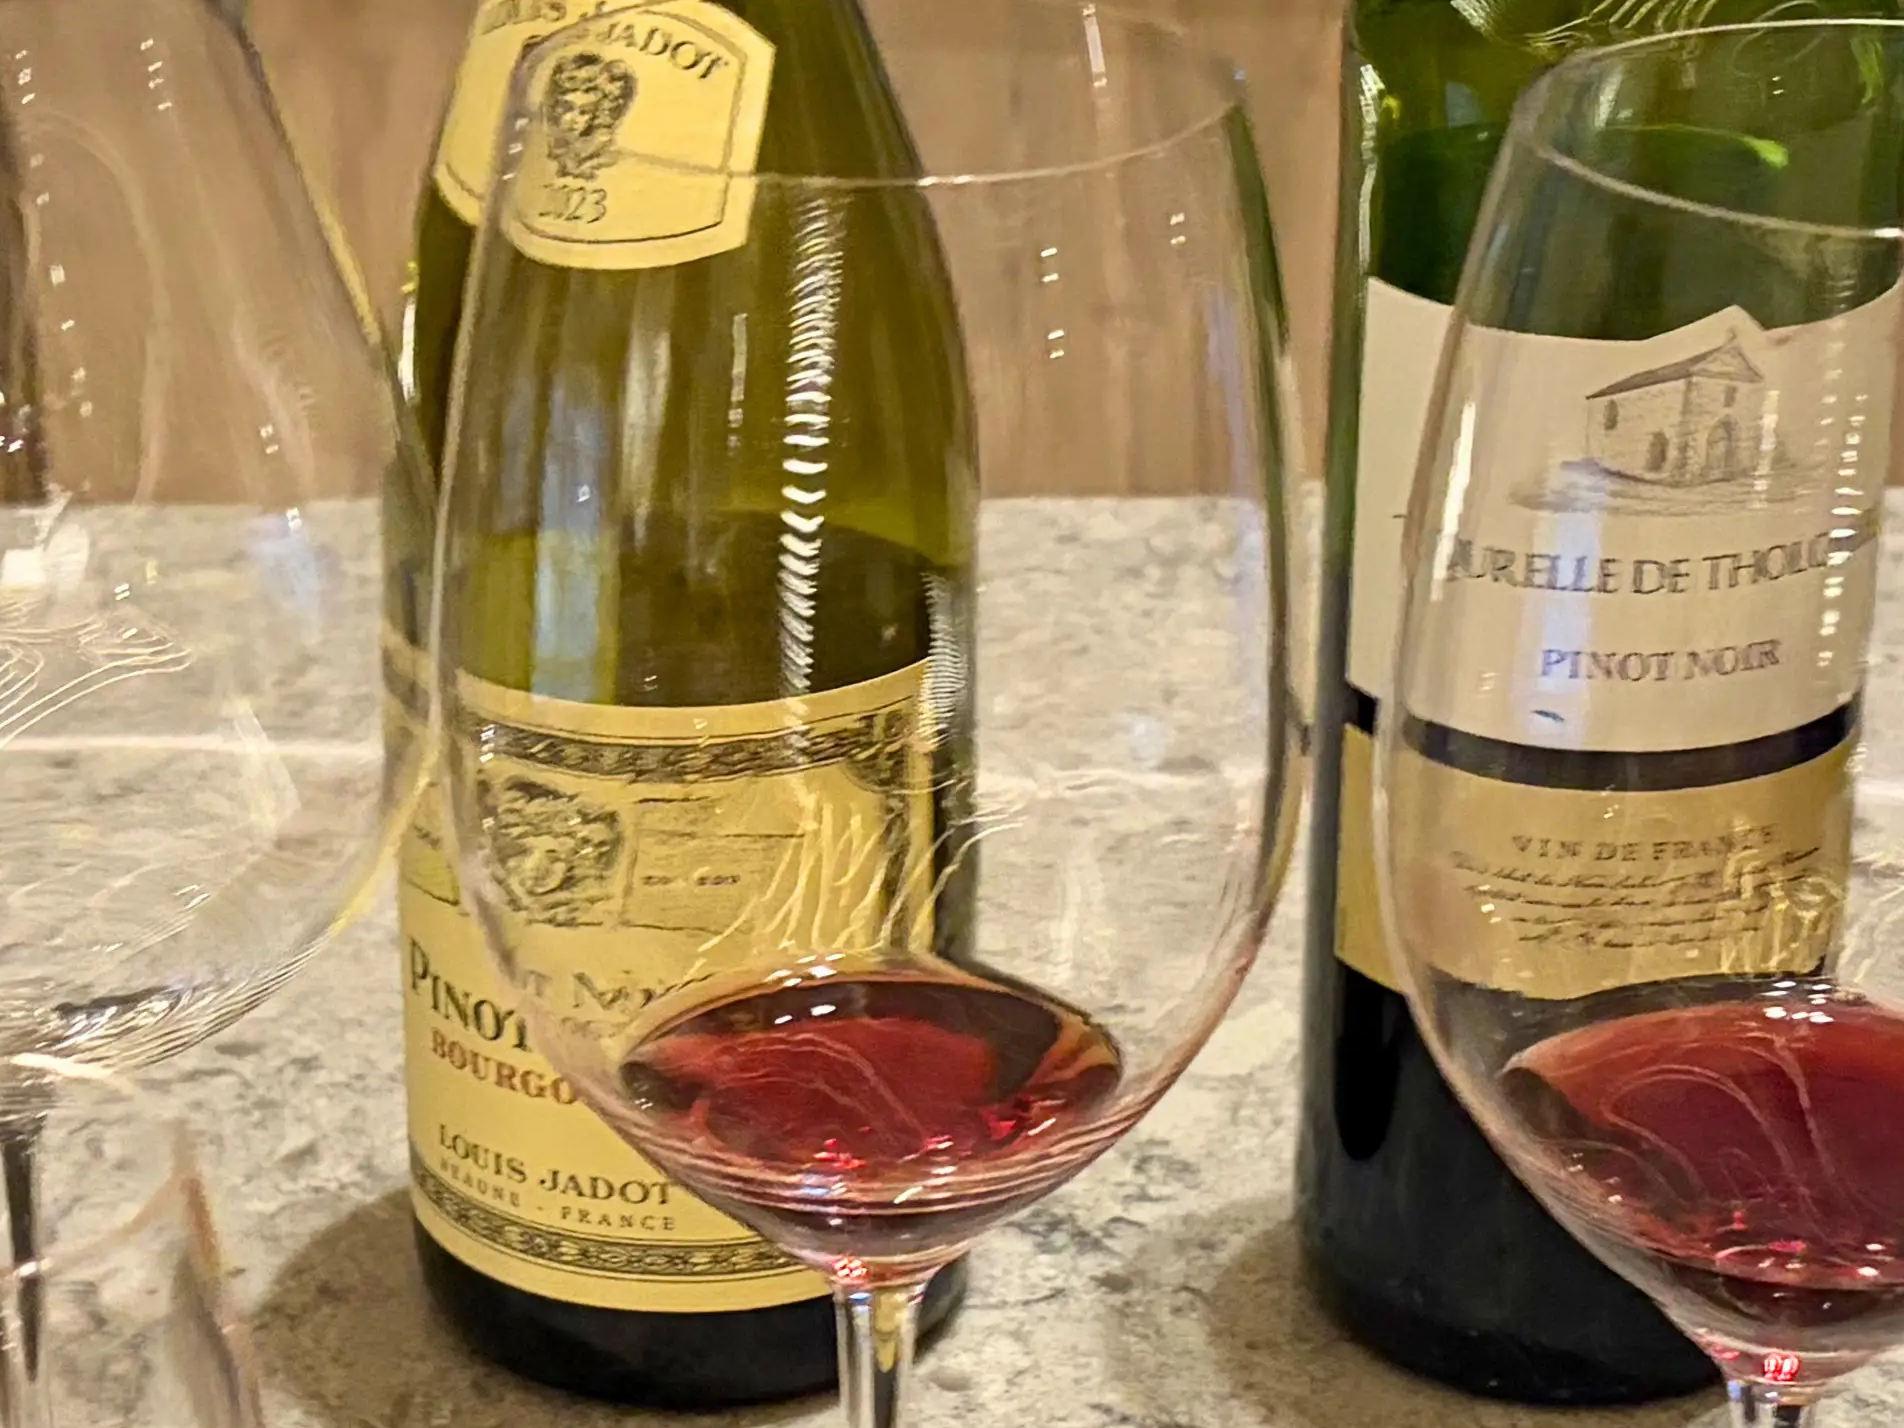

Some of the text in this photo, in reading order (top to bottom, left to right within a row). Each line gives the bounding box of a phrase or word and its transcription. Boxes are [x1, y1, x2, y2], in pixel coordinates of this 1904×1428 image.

[1631, 557, 1691, 595] DE
[1540, 638, 1782, 682] PINOT NOIR
[432, 1026, 577, 1105] BOURGO
[438, 1124, 673, 1206] LOUIS JADOT
[440, 1157, 678, 1232] BEAUNE FRANCE
